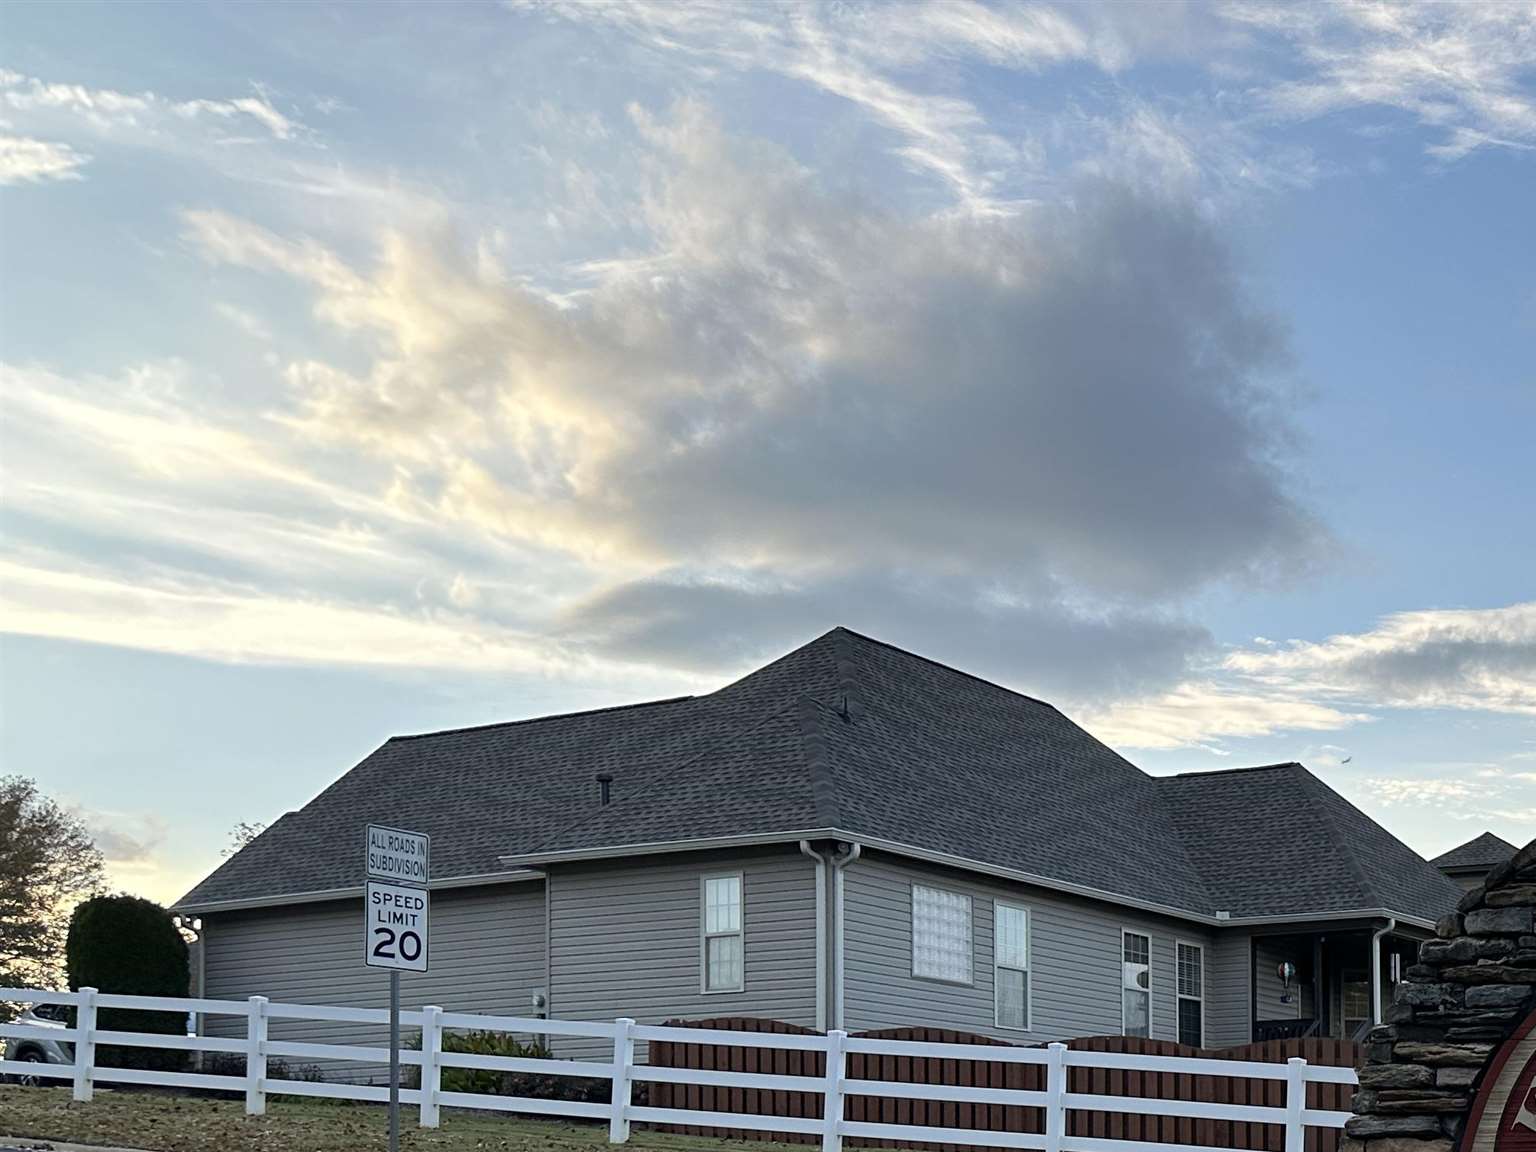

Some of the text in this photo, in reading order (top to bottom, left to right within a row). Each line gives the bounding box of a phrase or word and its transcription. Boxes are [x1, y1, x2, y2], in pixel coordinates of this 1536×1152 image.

[370, 831, 426, 857] ALL ROADS IN
[369, 853, 426, 877] SUBDIVISION
[372, 891, 424, 910] SPEED
[377, 909, 418, 927] LIMIT
[373, 927, 422, 961] 20
